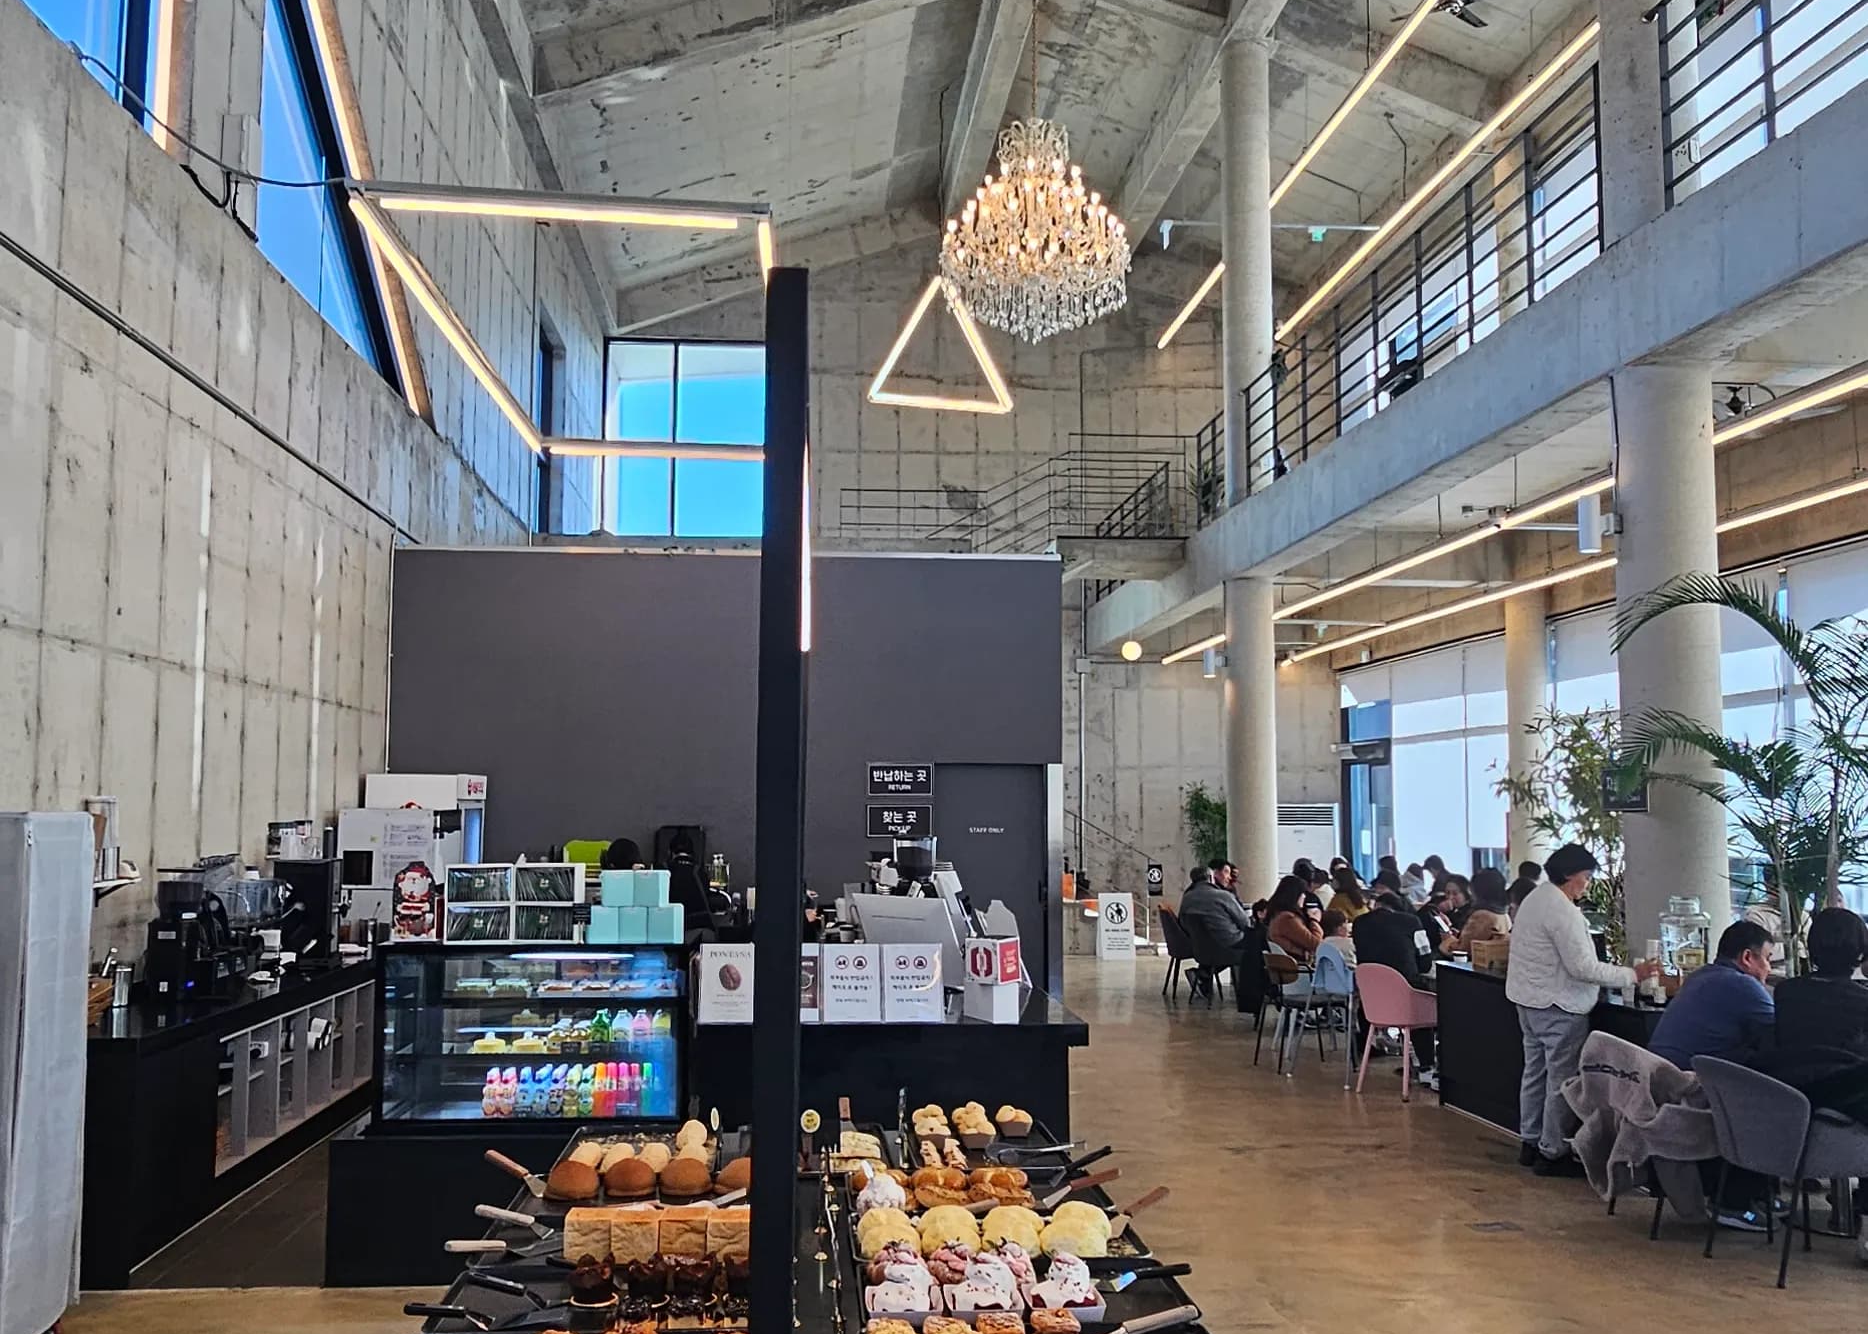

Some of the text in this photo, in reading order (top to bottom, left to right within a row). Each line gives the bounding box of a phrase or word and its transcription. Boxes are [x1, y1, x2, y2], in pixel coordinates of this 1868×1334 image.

[873, 770, 926, 782] 반납하는 곳
[882, 811, 917, 823] 찾는 곳
